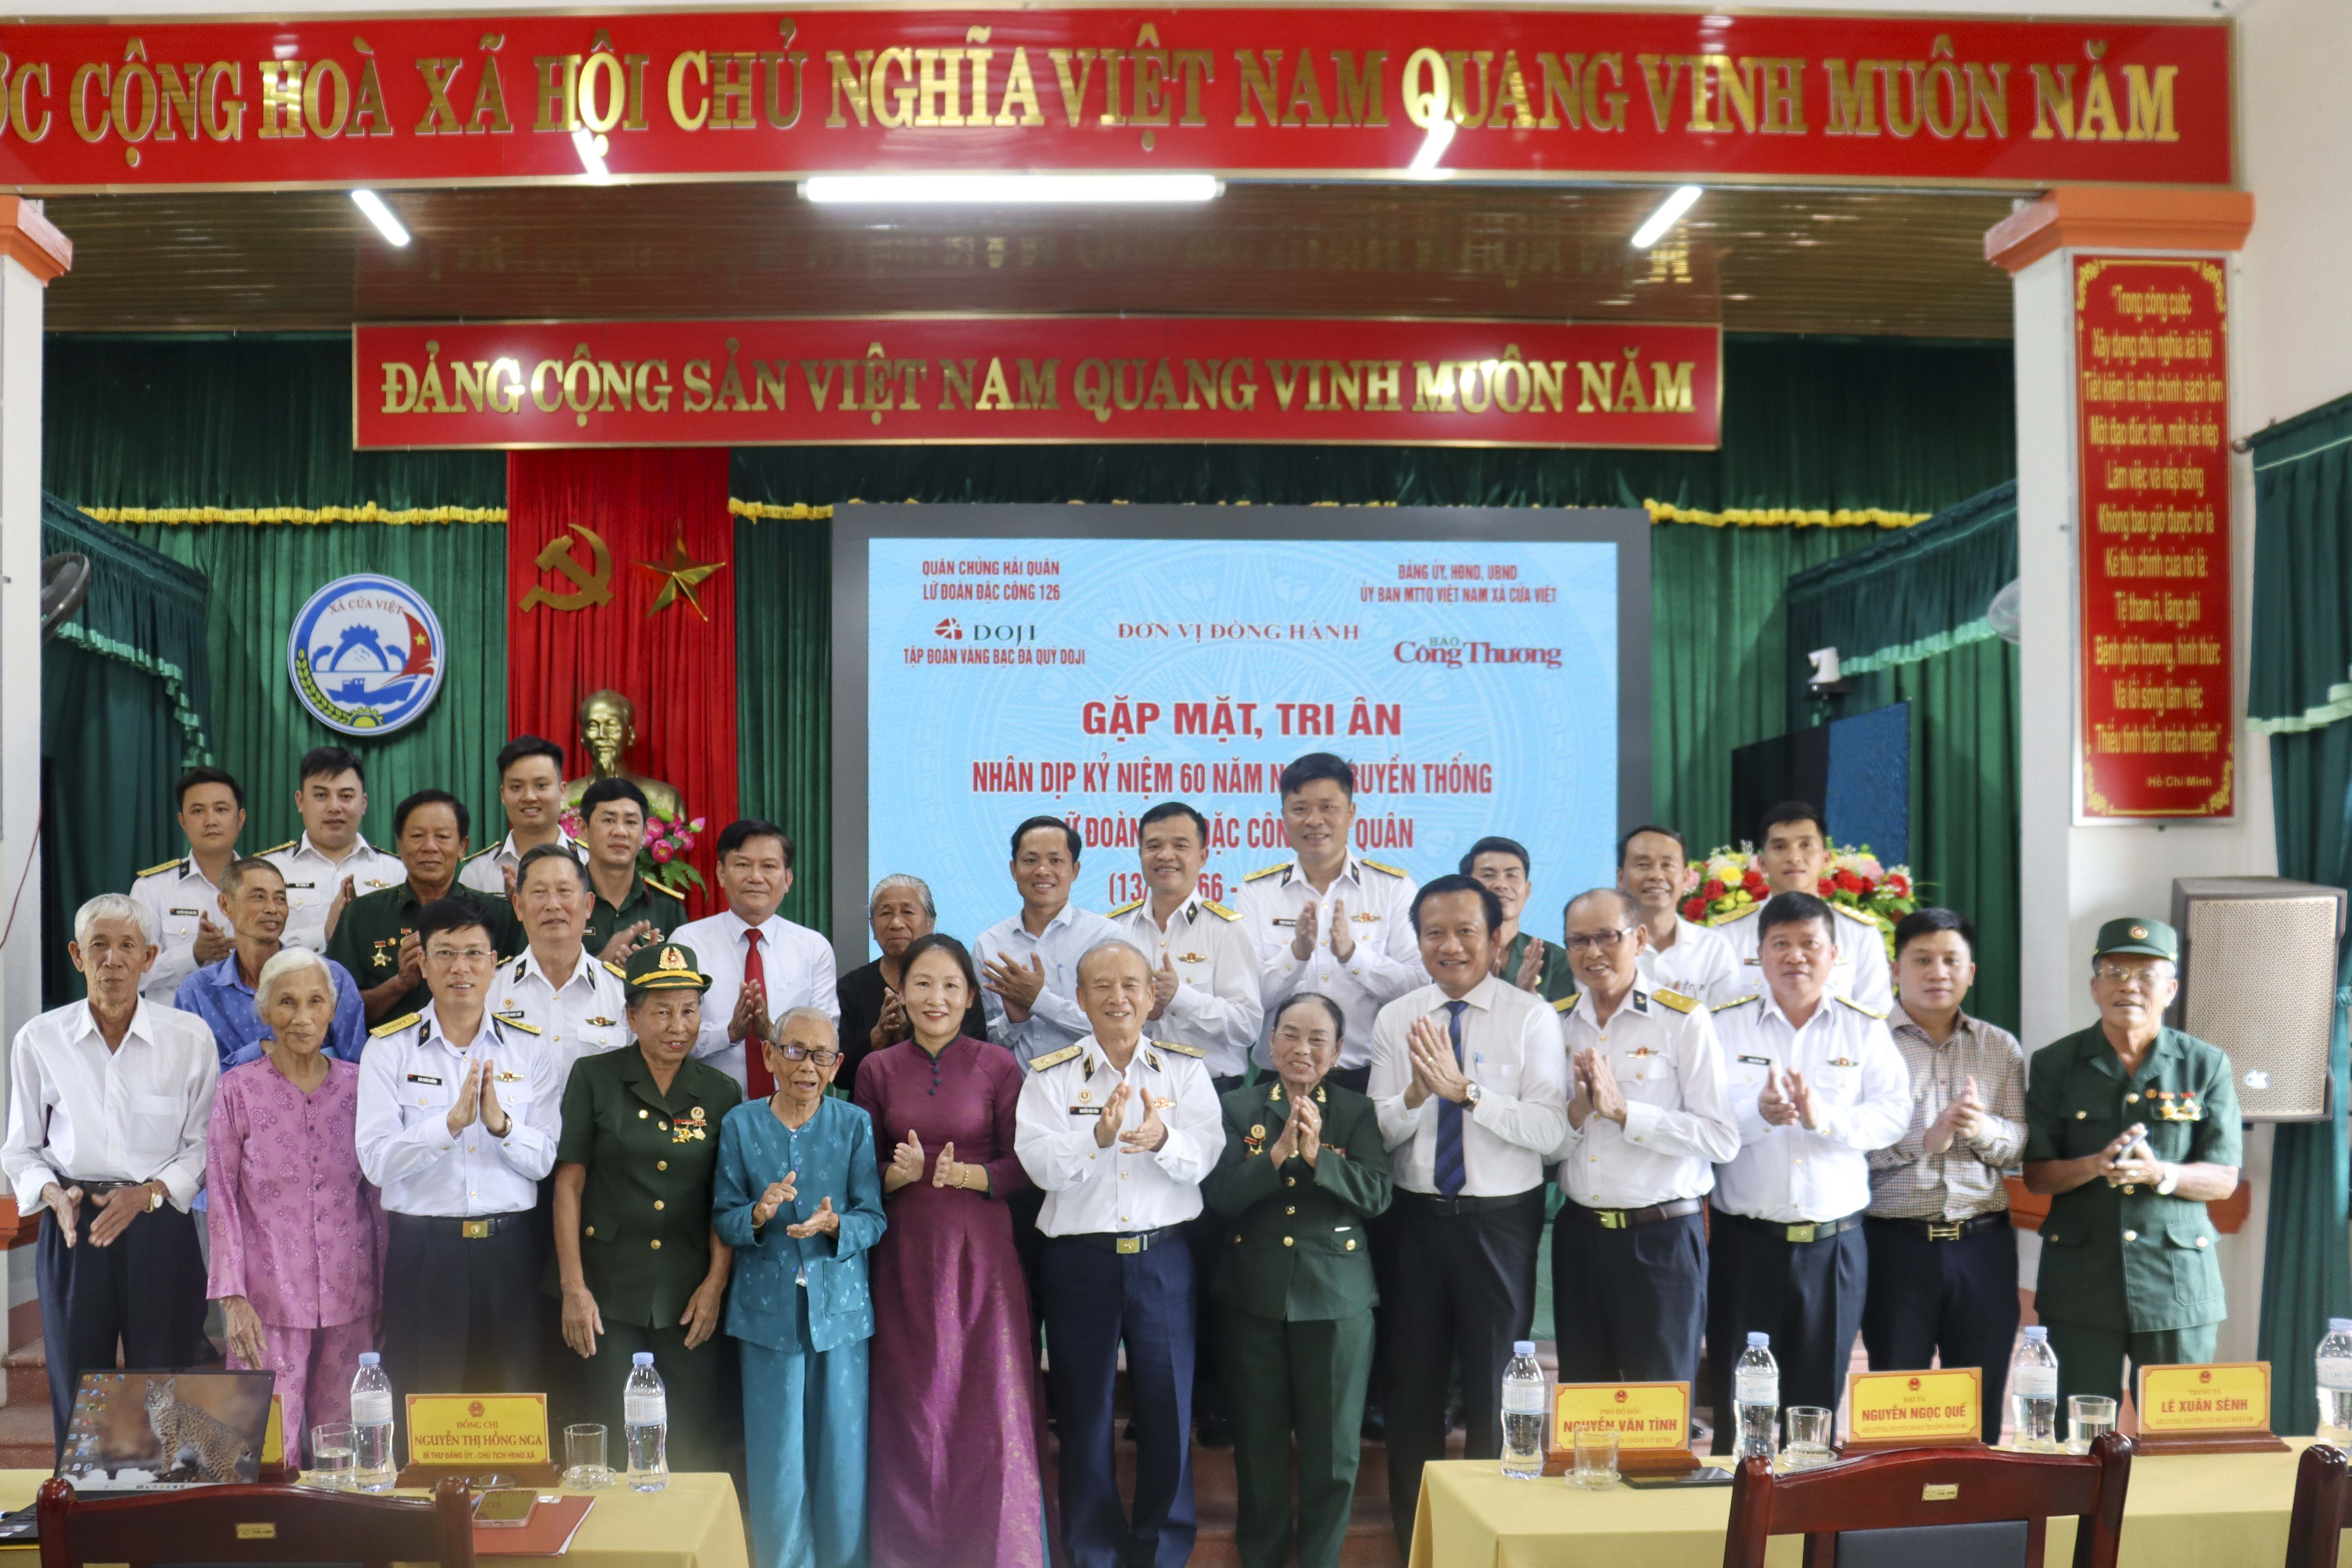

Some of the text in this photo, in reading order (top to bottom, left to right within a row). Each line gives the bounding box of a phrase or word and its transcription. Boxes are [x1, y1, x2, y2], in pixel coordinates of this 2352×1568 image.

[70, 38, 247, 167] CỘNG
[257, 37, 391, 138] HOÀ
[415, 32, 512, 134] XÃ
[533, 29, 649, 158] HỘI
[668, 18, 808, 132] CHỦ
[826, 25, 1045, 128] NGHĨA
[1047, 23, 1214, 151] VIỆT
[1235, 49, 1389, 129] NAM
[1402, 47, 1626, 132] QUANG
[1637, 53, 1807, 134] VINH
[1824, 34, 2011, 139] MUÔN
[2031, 39, 2180, 142] NĂM
[381, 337, 1696, 426] ĐẢNG CỘNG SẢN VIỆT NAM QUANG VINH MUÔN NĂM
[922, 556, 1060, 576] QUÂN CHỦNG HẢI QUÂN
[1398, 560, 1429, 580] ĐẢNG
[1487, 564, 1517, 580] UBND
[923, 581, 1060, 604] LỮ ĐOÀN ĐẶC CÔNG 126
[1360, 581, 1557, 606] ỦY BAN MTTQ VIỆT NAM XÃ CỬA VIỆT
[973, 624, 1037, 646] DOJI
[1117, 619, 1360, 643] ĐƠN VỊ ĐỒNG HÀNH
[1430, 634, 1460, 647] BÁO
[903, 645, 1085, 668] TẬP ĐOÀN VÀNG BẠC ĐÁ QUÝ DOJI
[1394, 641, 1463, 670] Công
[1082, 694, 1402, 742] GẶP MẶT, TRI ÂN
[973, 755, 1033, 793] NHÂN
[1040, 762, 1076, 800] DỊP
[1082, 751, 1110, 793] KỶ
[1117, 756, 1173, 800] NIỆM
[1180, 762, 1206, 793] 60
[1212, 757, 1263, 794] NĂM
[1352, 753, 1416, 794] RUYỀN
[1423, 752, 1492, 794] THỐNG
[1247, 811, 1293, 849] CÔN
[1355, 812, 1414, 852] QUÂN
[1862, 1401, 1967, 1421] NGUYỄN NGỌC QUẾ
[2161, 1397, 2248, 1413] LÊ XUÂN SÊNH
[1619, 1418, 1644, 1432] VĂN
[1649, 1417, 1677, 1431] TÌNH
[414, 1430, 543, 1448] NGUYỄN THỊ HỒNG NGA
